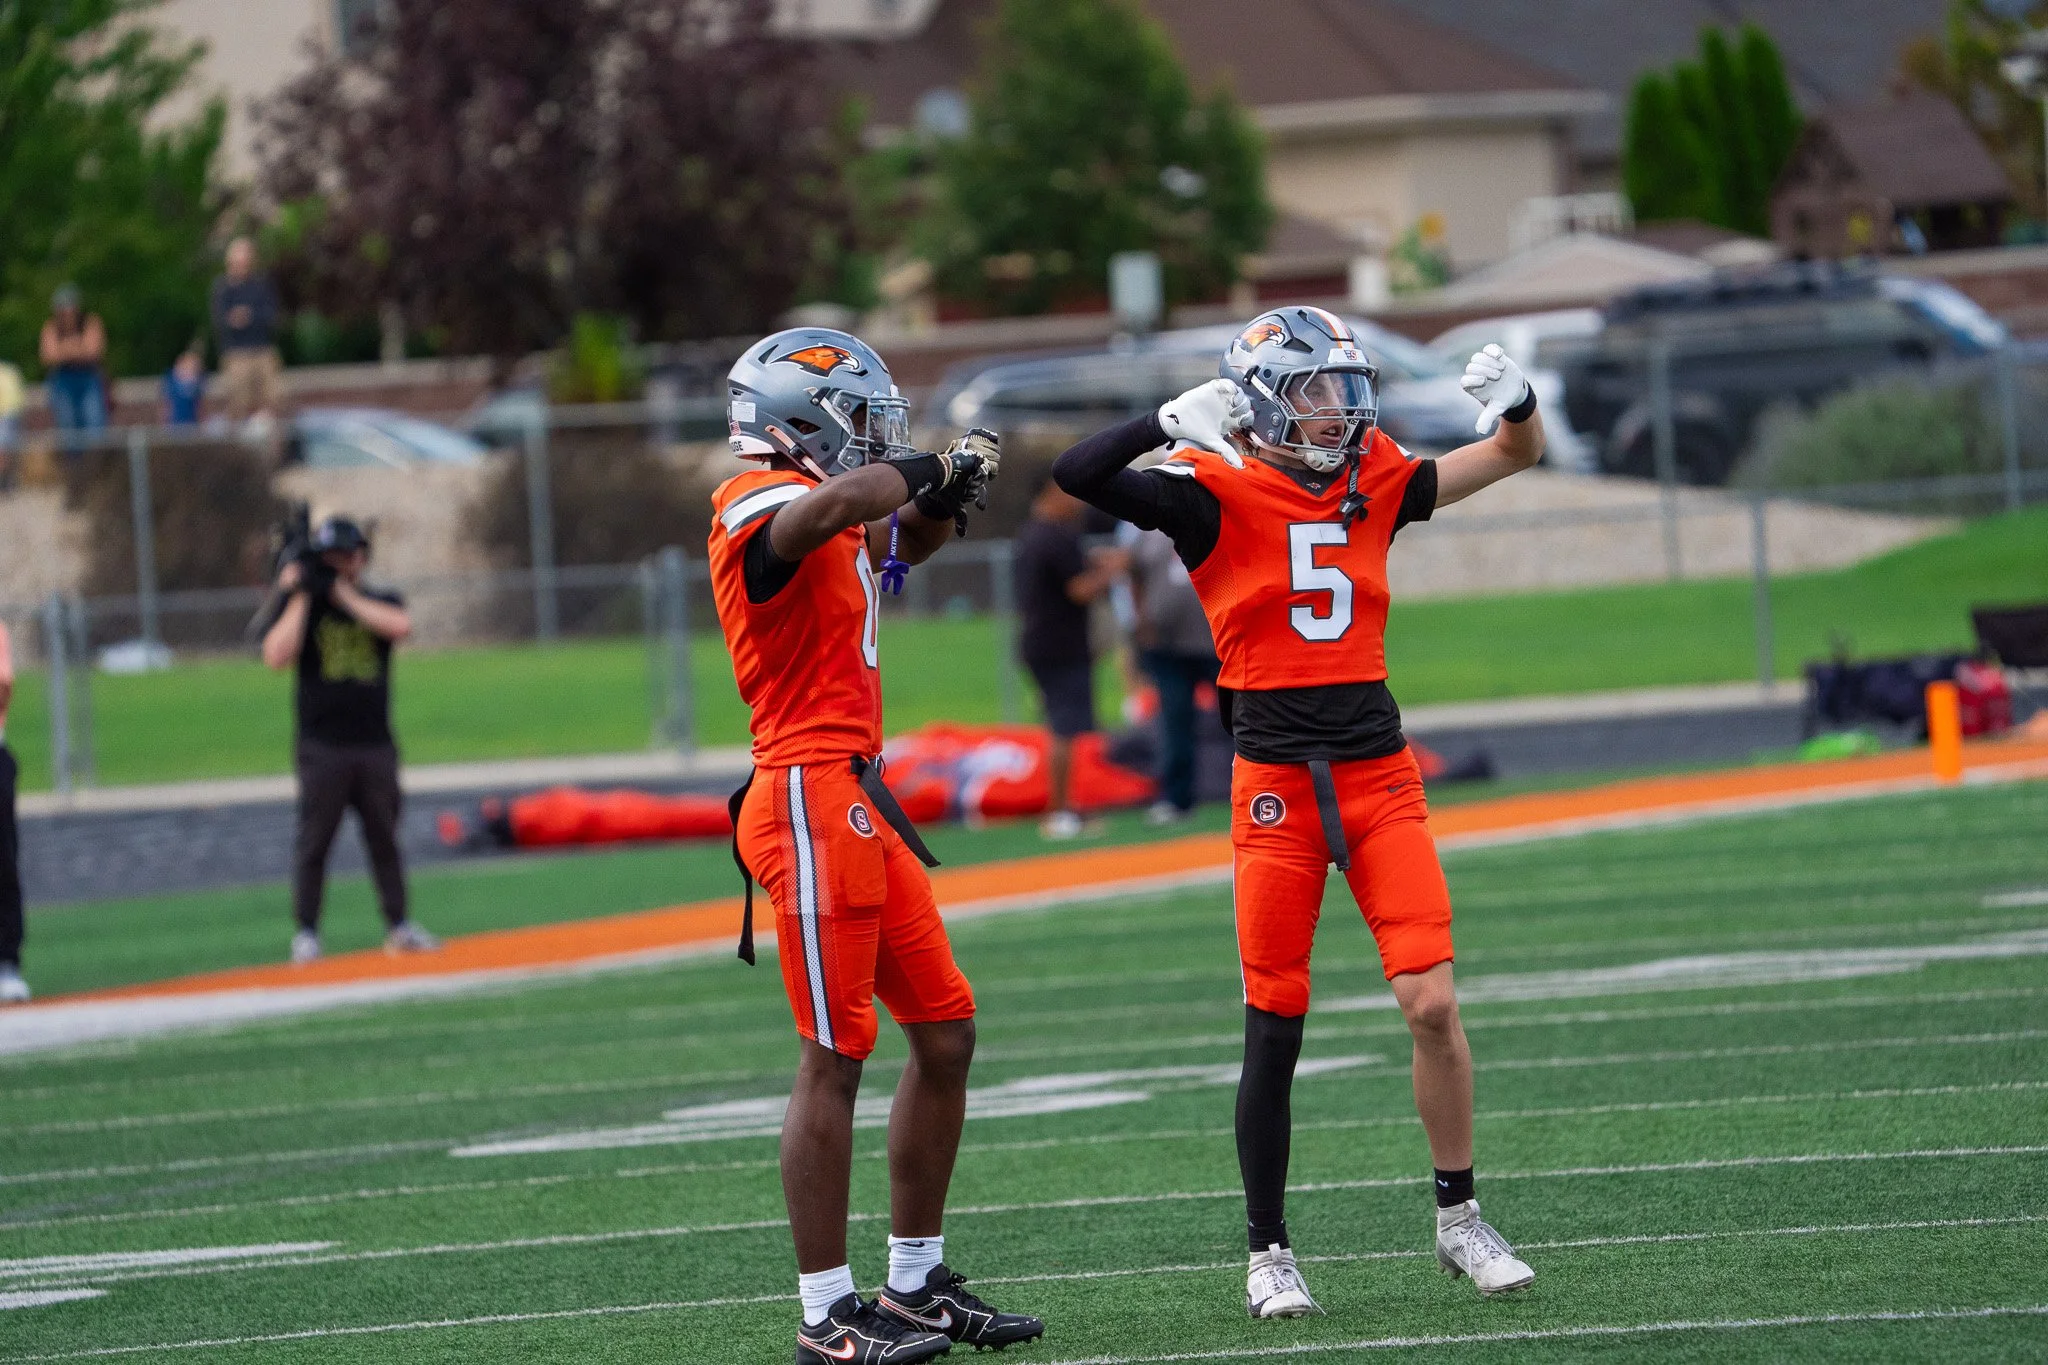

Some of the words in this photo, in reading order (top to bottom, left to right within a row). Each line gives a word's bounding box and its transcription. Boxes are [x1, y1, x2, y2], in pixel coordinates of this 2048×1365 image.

[890, 526, 898, 556] NXTRND
[1287, 521, 1354, 643] 5
[855, 810, 870, 831] S
[1259, 799, 1277, 822] S
